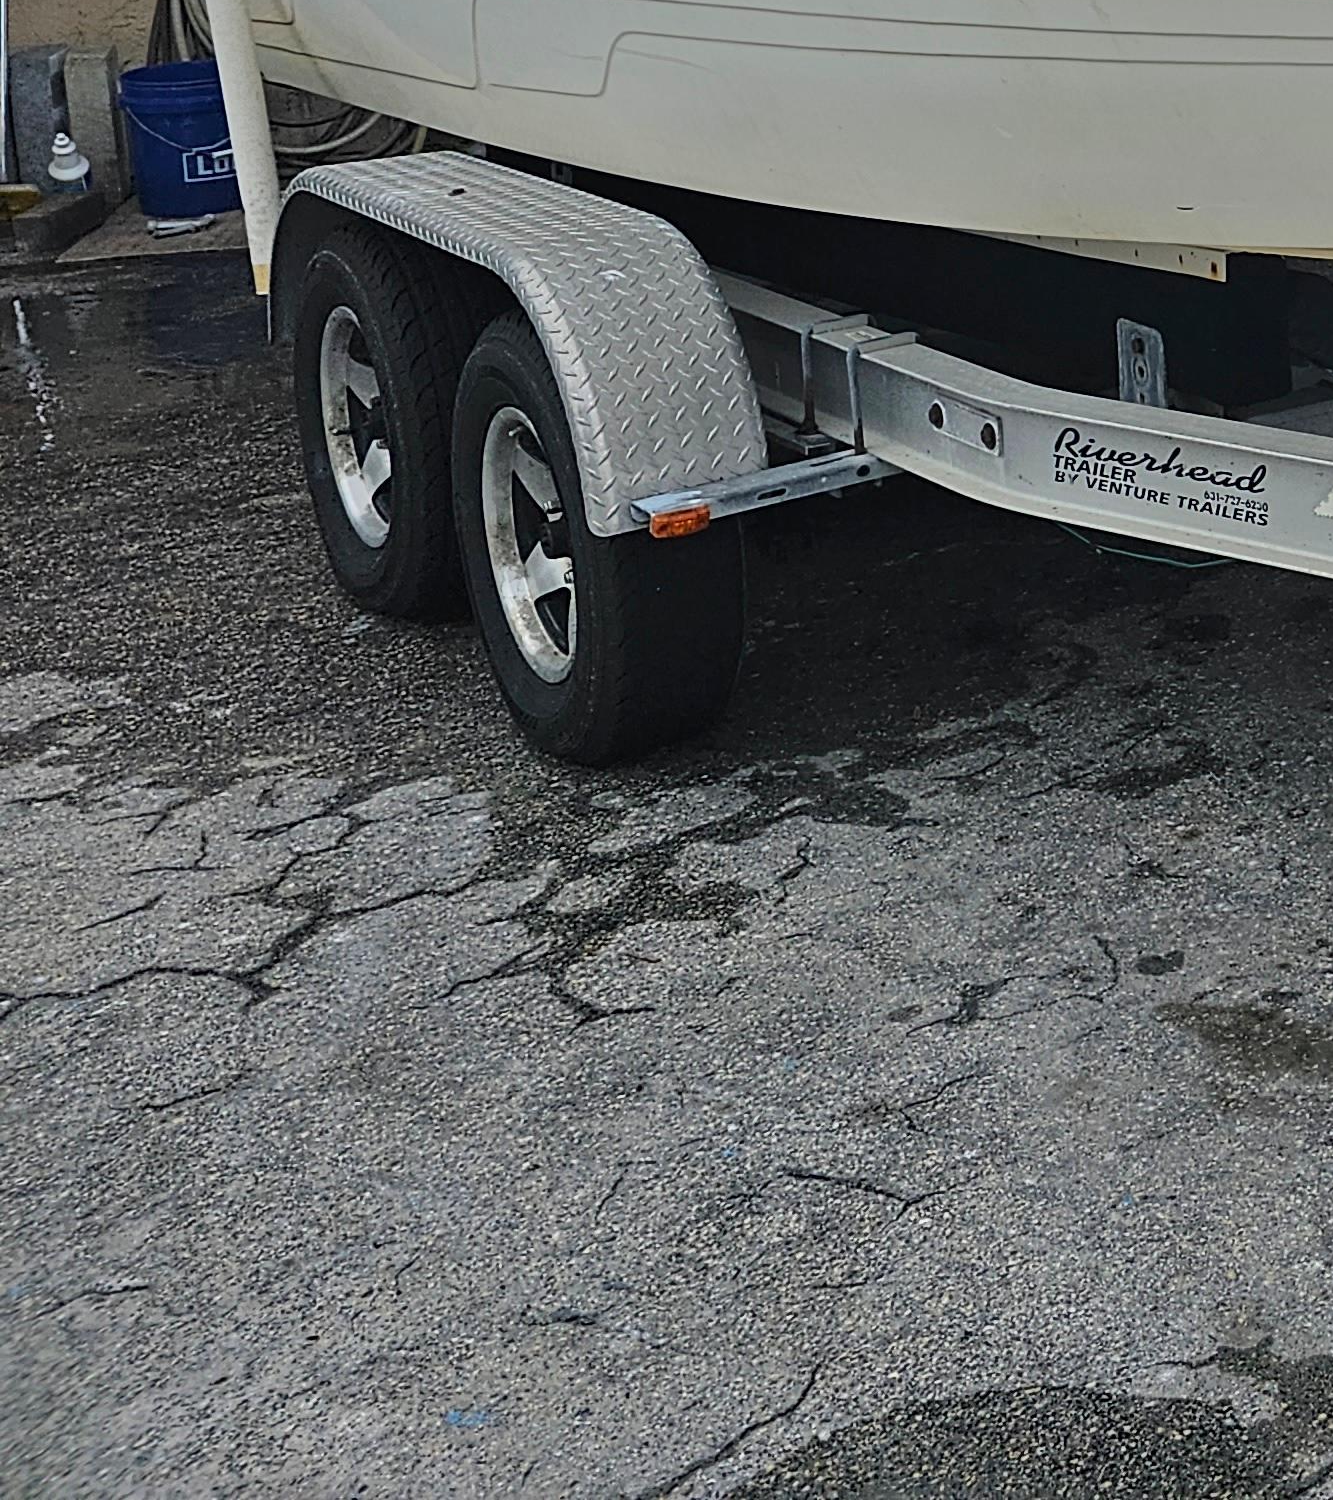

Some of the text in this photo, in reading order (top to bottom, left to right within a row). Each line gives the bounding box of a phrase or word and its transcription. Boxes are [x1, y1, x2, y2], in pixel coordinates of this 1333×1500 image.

[1053, 454, 1137, 484] TRAILER
[1054, 427, 1267, 493] Riverhead
[1055, 471, 1269, 527] BY VENTURE TRAILERS
